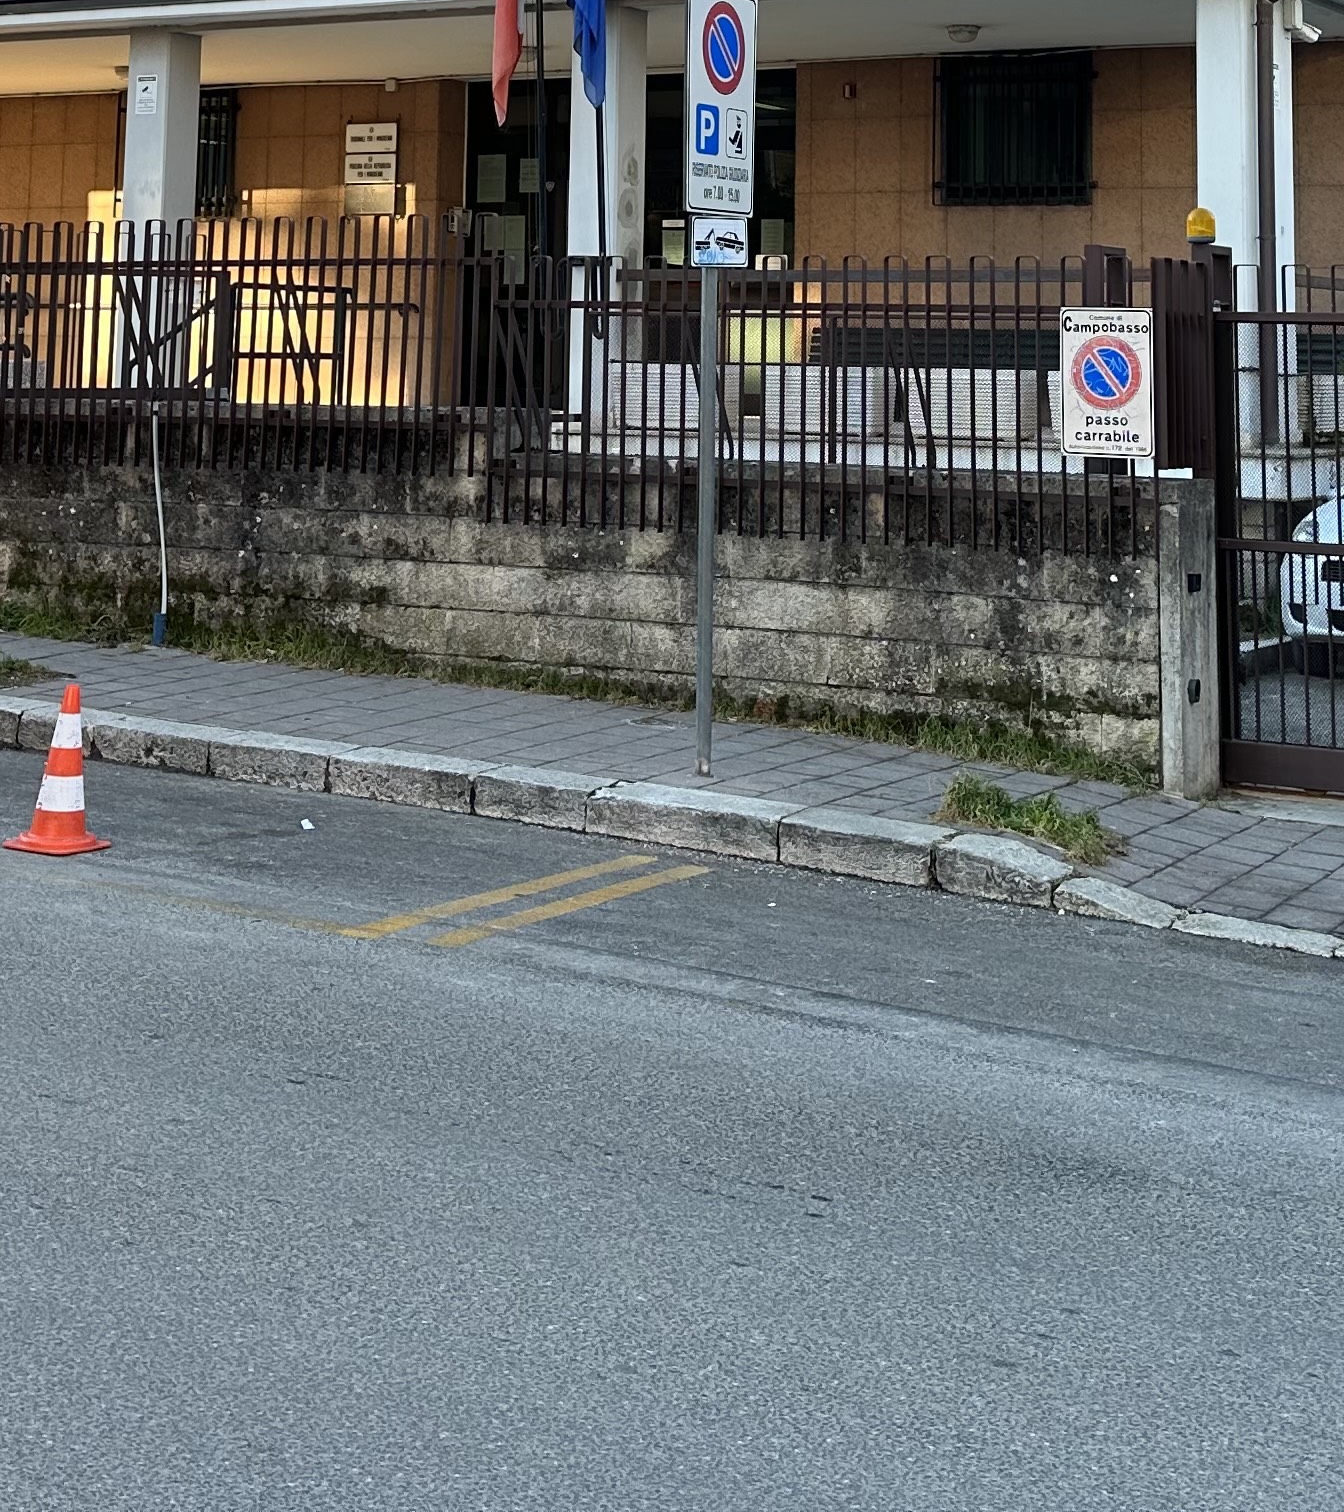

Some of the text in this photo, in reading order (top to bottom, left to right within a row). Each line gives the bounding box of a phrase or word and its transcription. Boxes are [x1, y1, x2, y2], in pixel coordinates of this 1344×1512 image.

[700, 110, 716, 150] P
[1063, 316, 1149, 335] Campobasso
[1086, 416, 1128, 427] passo
[1075, 430, 1140, 443] carrabile
